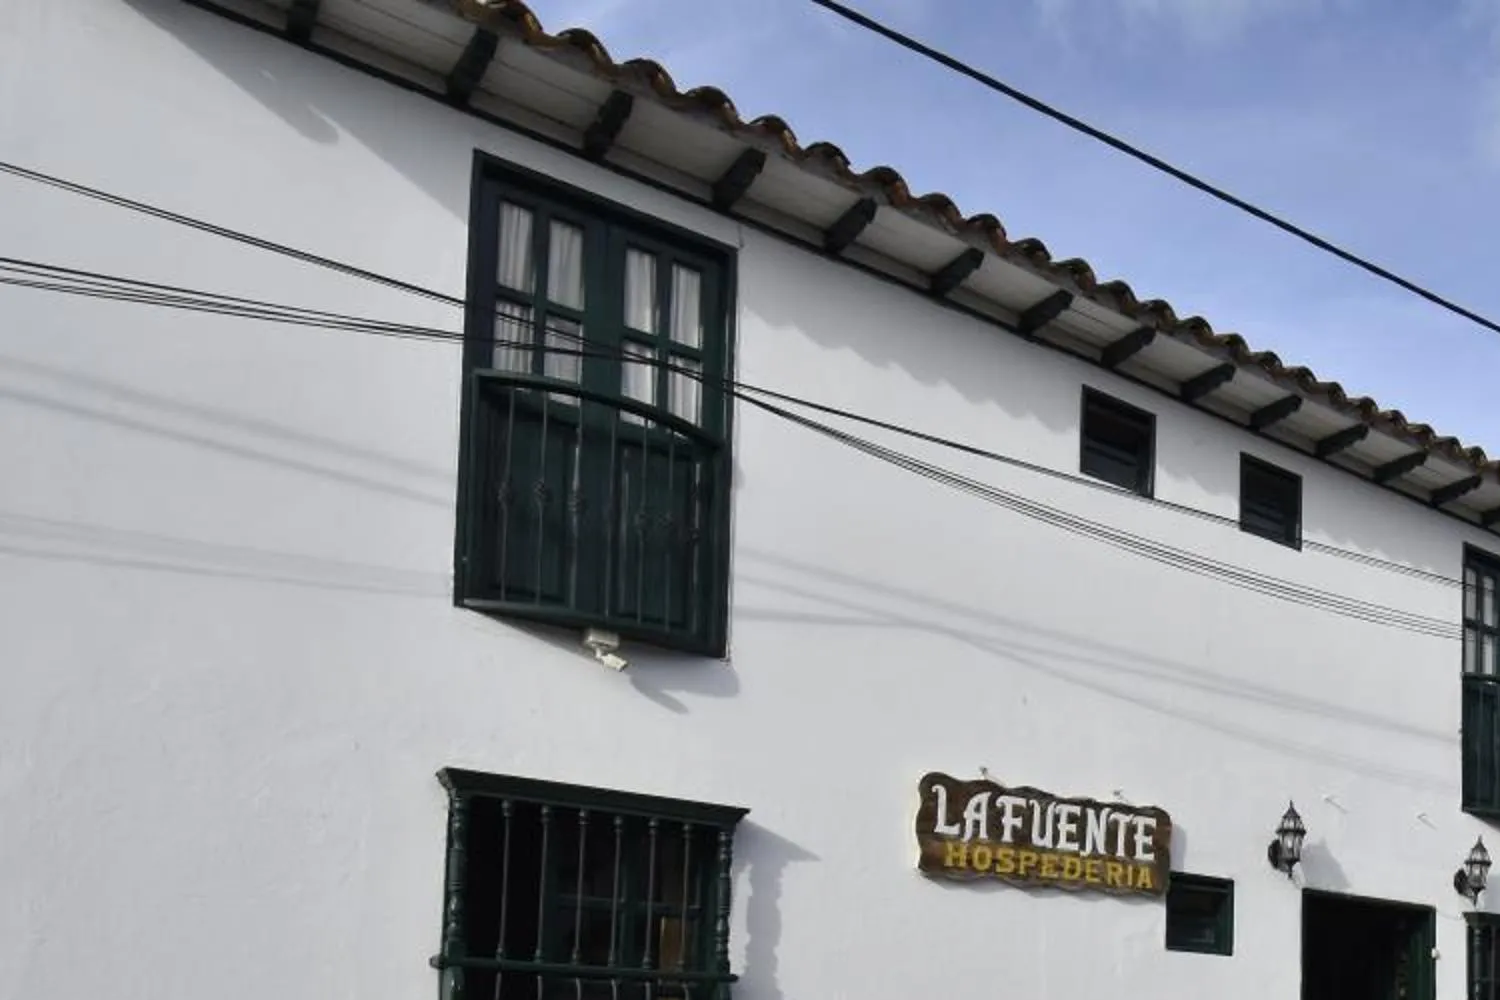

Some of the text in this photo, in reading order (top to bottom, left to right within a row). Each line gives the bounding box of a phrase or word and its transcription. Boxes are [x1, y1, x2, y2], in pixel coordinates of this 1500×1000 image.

[932, 784, 1157, 861] LA FUENTE
[944, 841, 1153, 889] HOSPEDERIA
